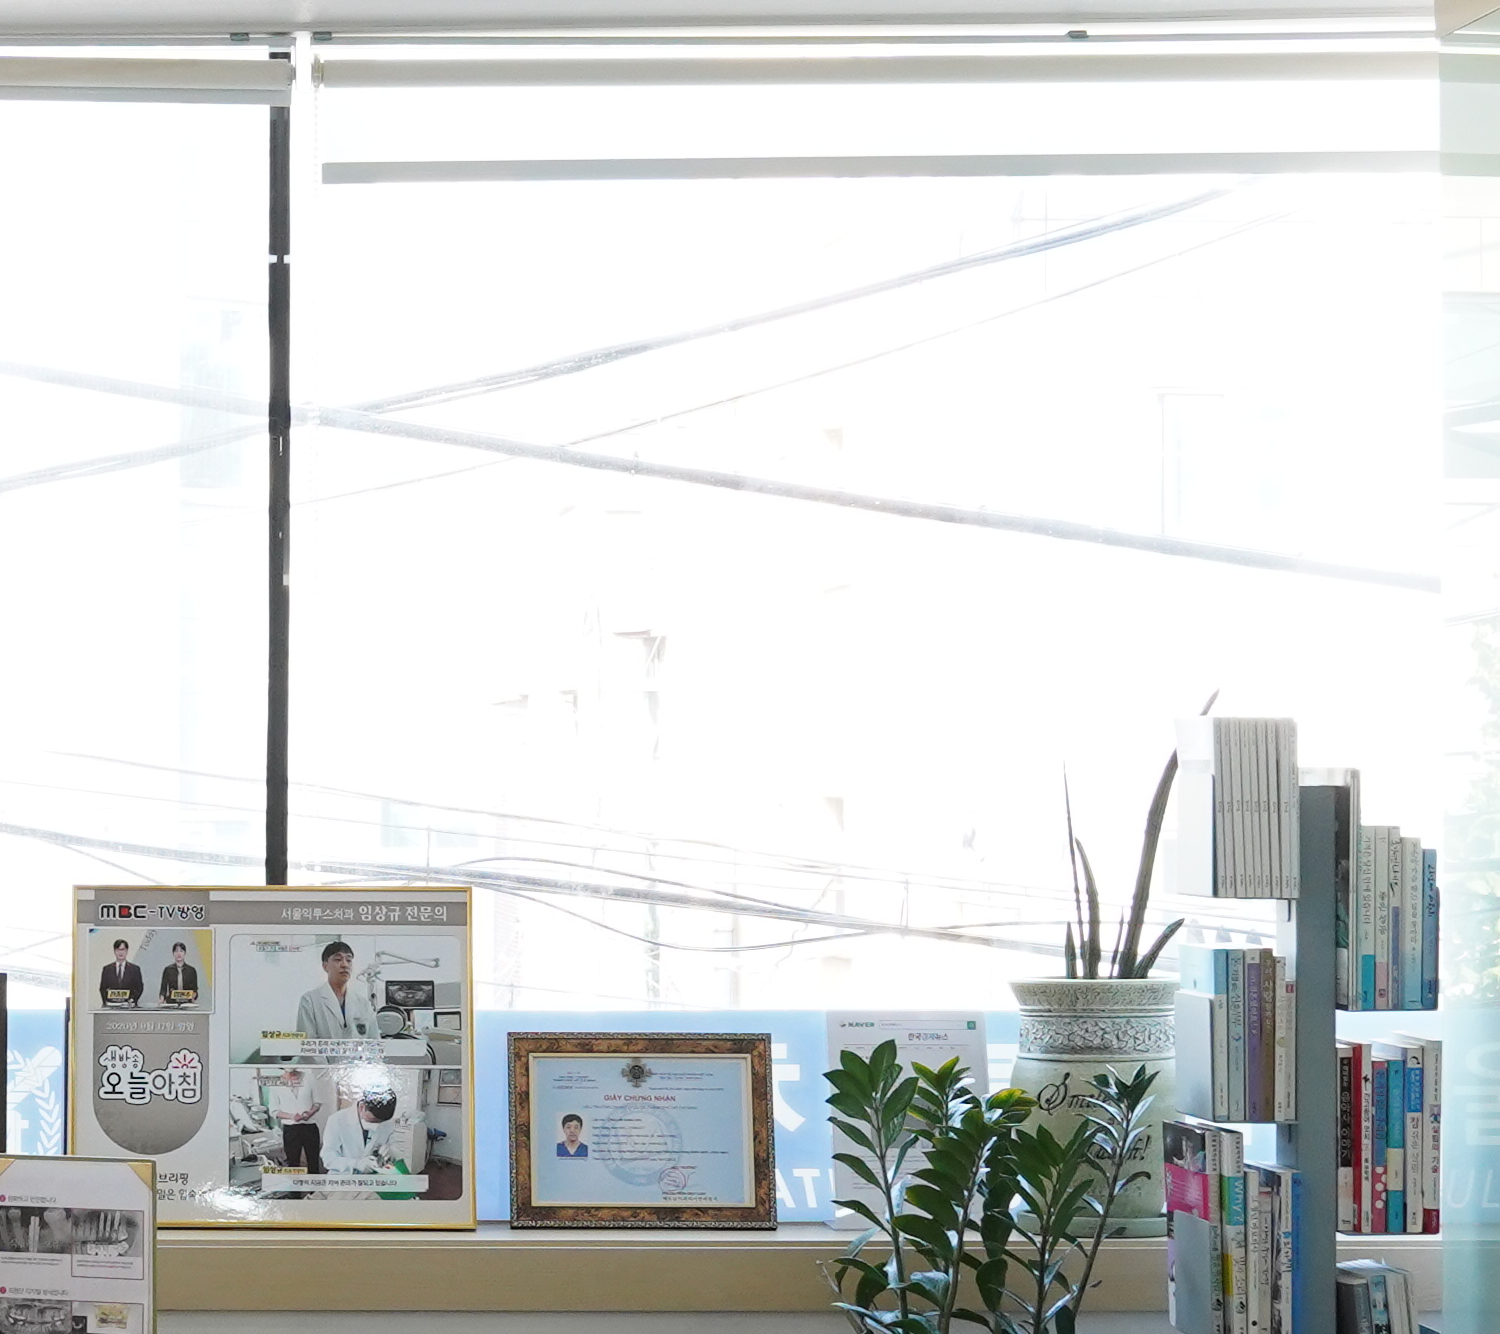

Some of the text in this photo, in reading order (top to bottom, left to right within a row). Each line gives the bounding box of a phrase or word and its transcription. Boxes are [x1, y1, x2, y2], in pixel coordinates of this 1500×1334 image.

[358, 905, 401, 922] 임상규
[405, 905, 447, 922] 전문의
[907, 1032, 949, 1041] 한국경제뉴스
[103, 1050, 139, 1069] 생방송
[103, 1071, 197, 1099] 오늘아침
